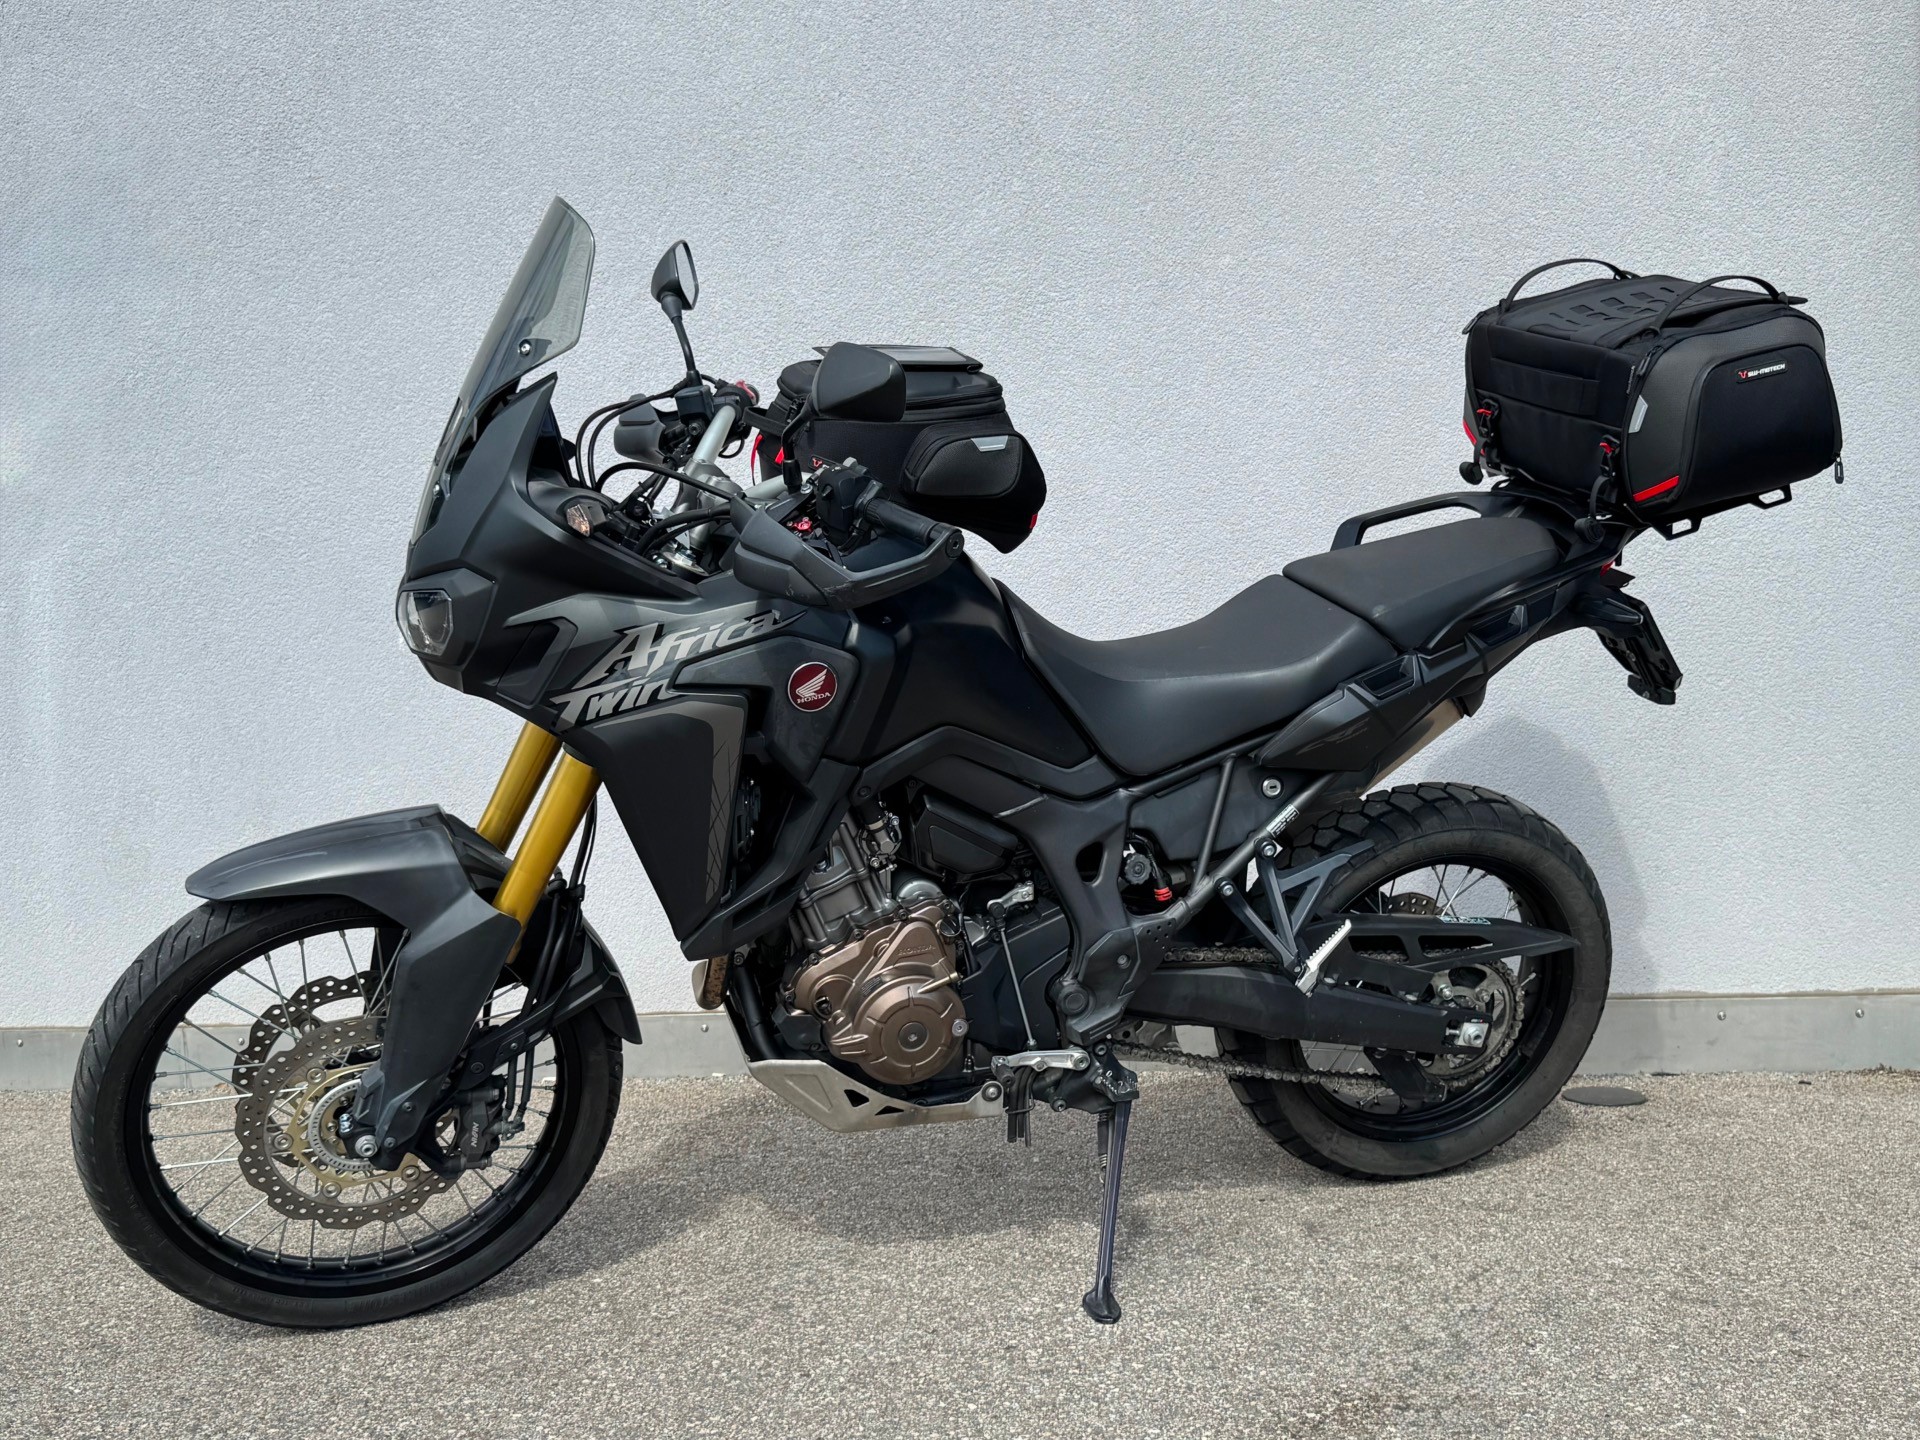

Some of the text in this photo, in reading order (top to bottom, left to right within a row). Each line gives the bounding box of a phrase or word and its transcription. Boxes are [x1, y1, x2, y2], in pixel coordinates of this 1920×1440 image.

[573, 609, 806, 690] Africa
[551, 677, 680, 730] Twin
[797, 692, 831, 704] HONDA
